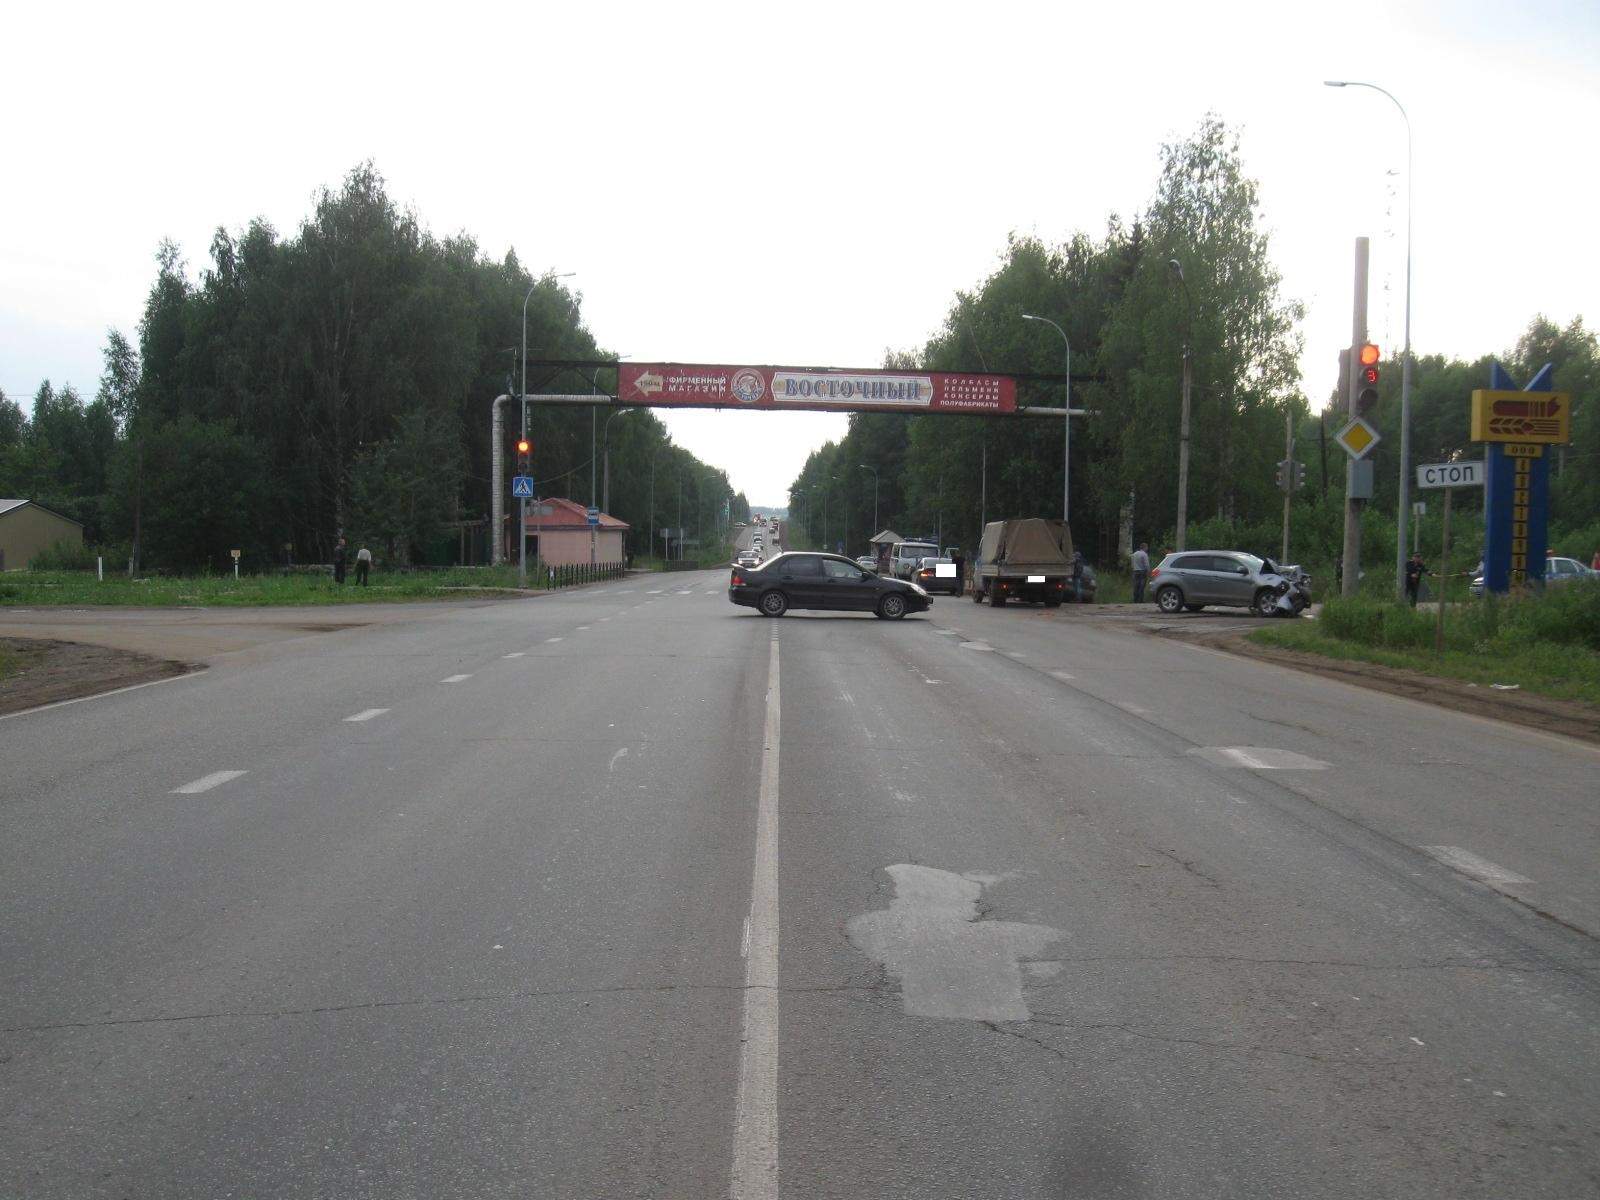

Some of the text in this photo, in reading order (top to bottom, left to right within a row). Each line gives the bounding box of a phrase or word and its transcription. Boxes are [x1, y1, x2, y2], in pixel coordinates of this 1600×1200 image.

[669, 375, 726, 384] ФИРМЕННЫЙ
[944, 378, 999, 386] КОЛБАСЫ
[668, 384, 726, 392] МАГАЗИН
[785, 378, 921, 399] ВОСТОЧНЫЙ
[940, 400, 999, 408] ПОЛУФАБРИКАТЫ
[1425, 465, 1475, 484] СТОП
